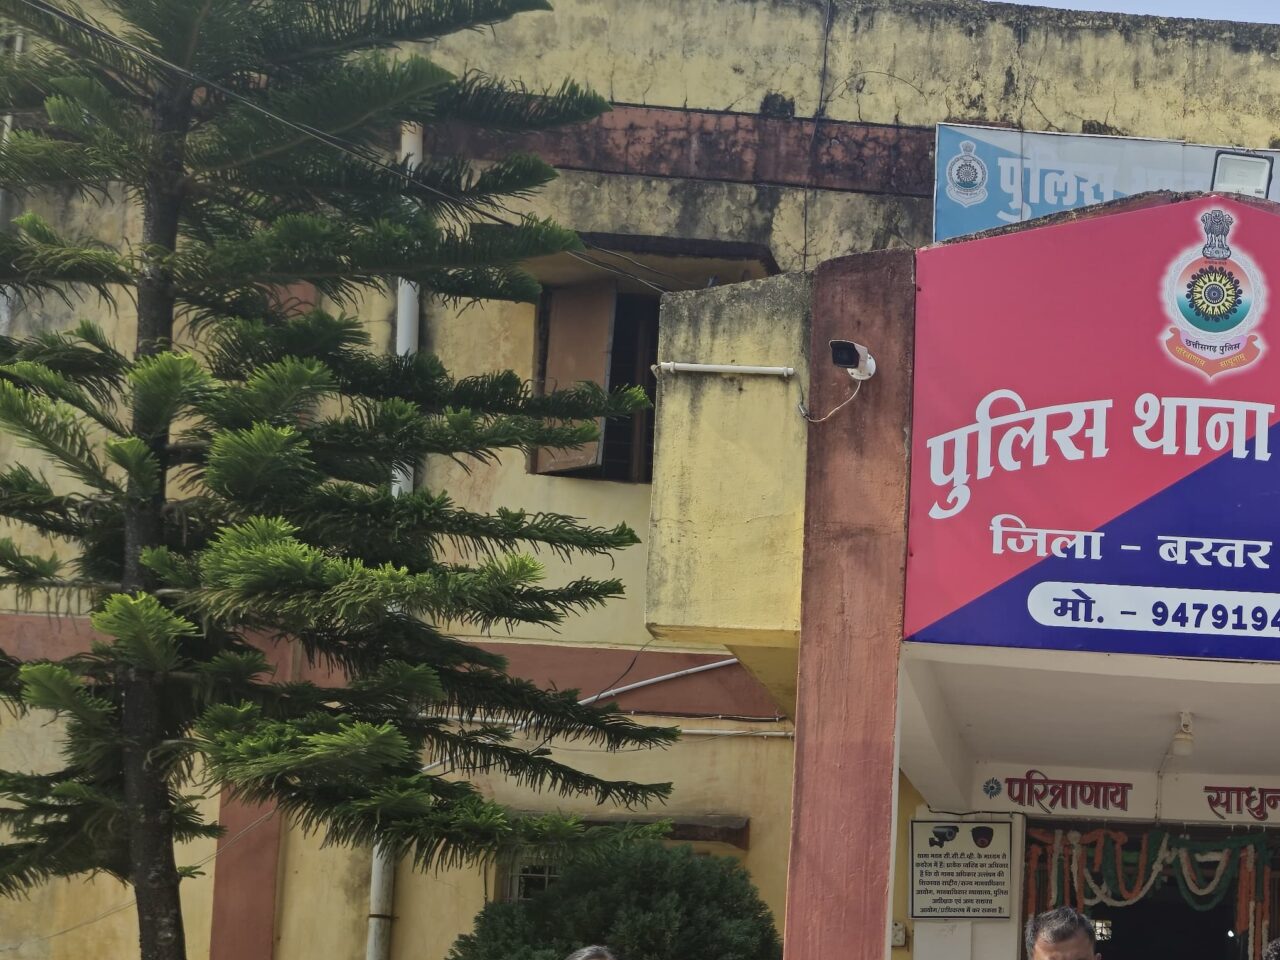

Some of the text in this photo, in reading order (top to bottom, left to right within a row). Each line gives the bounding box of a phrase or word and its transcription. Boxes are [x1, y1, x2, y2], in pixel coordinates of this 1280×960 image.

[1219, 341, 1241, 355] पुलिस
[926, 388, 1114, 520] पुलिस
[1132, 392, 1276, 462] थाना
[989, 513, 1105, 560] जिला
[1157, 535, 1273, 569] बस्तर
[1052, 588, 1105, 624] मो.
[1004, 769, 1134, 814] परित्राणाय
